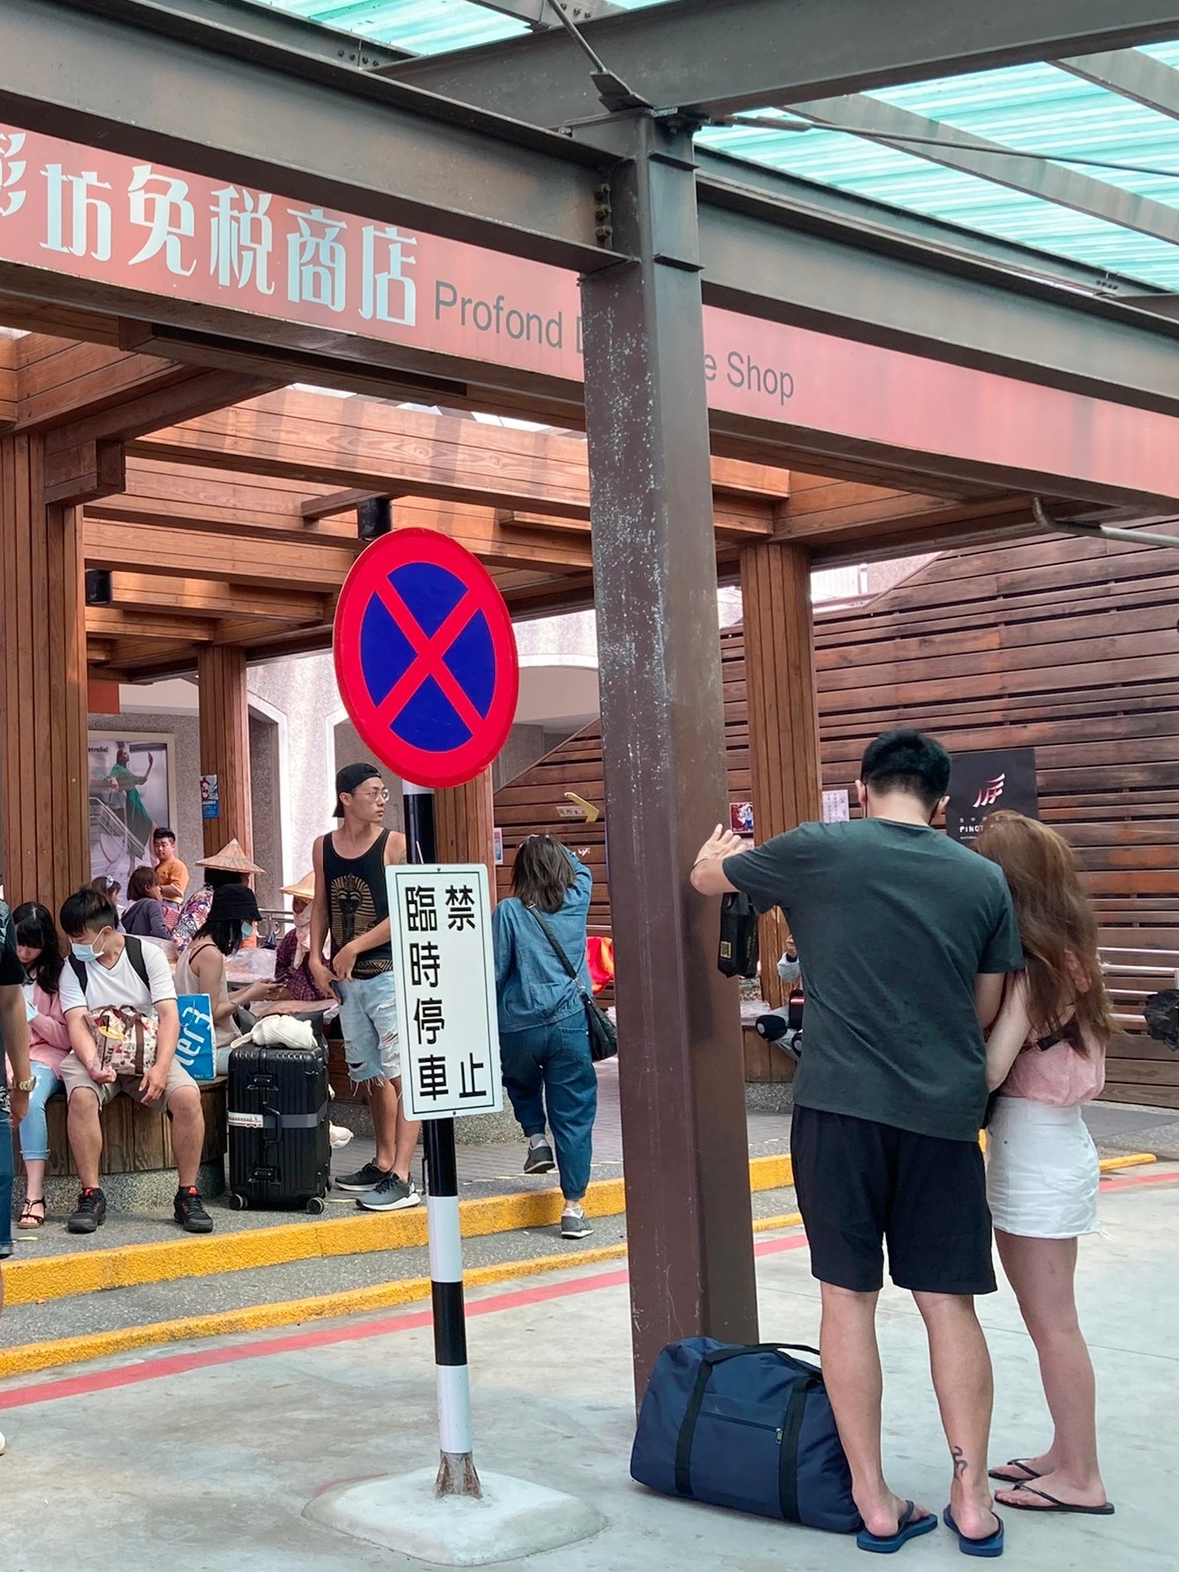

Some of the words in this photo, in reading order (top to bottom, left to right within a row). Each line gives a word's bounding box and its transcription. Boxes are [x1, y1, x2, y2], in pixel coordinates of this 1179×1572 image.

[435, 280, 563, 349] Profond
[727, 351, 795, 405] Shop
[405, 885, 449, 1101] 臨時停車
[445, 885, 487, 1098] 禁止
